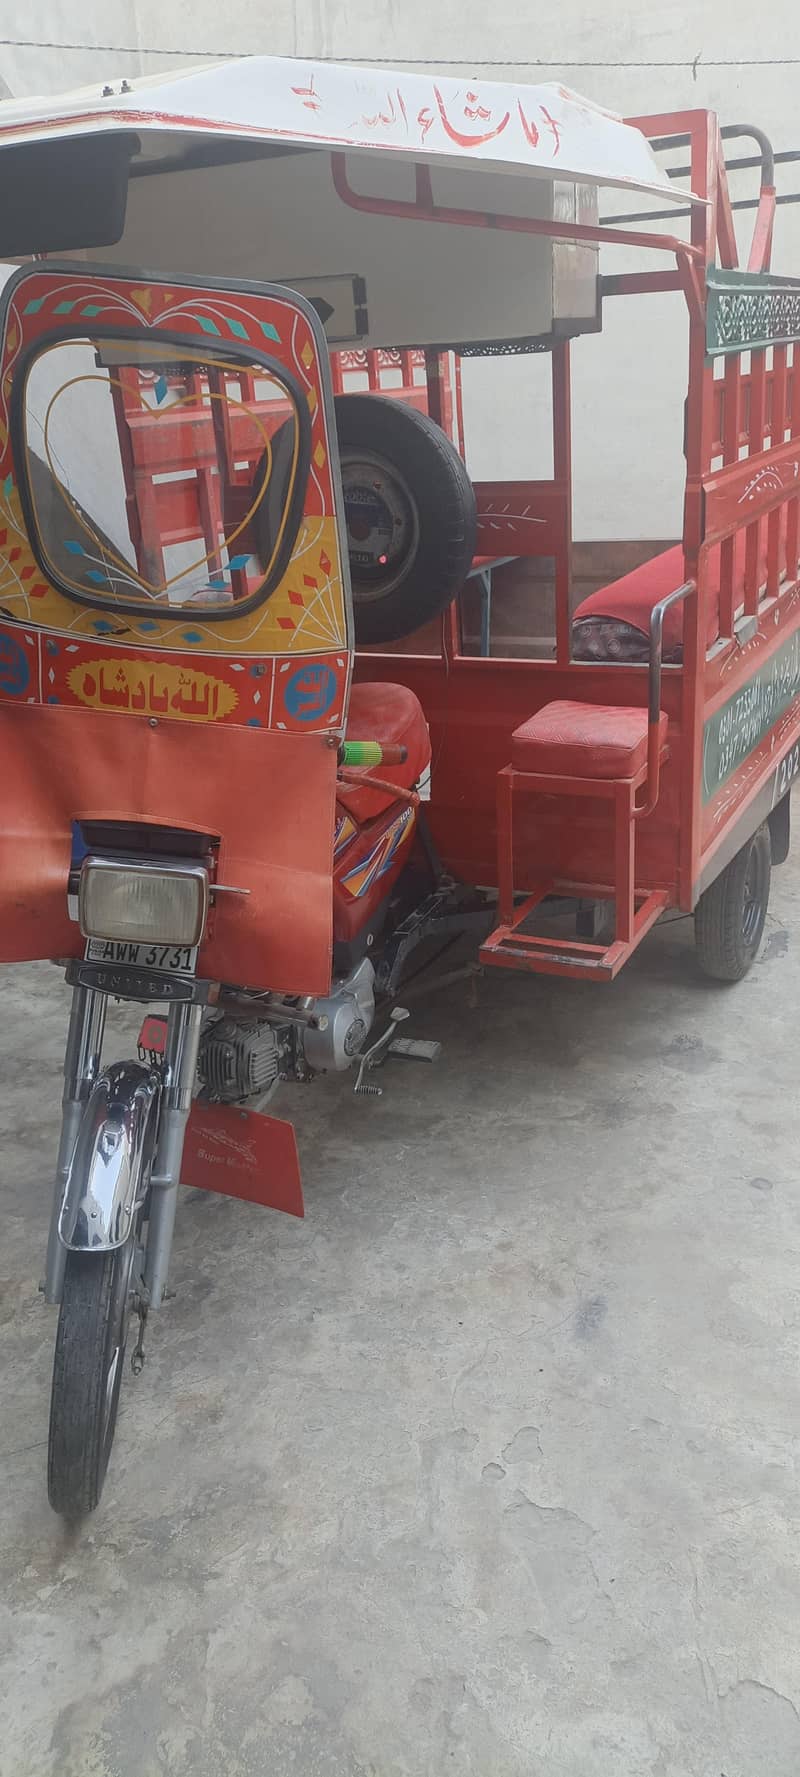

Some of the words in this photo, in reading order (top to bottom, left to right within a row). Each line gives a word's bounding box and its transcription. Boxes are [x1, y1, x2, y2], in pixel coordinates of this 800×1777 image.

[103, 941, 140, 963] AWW
[145, 945, 192, 971] 3731
[97, 971, 174, 994] UNITED
